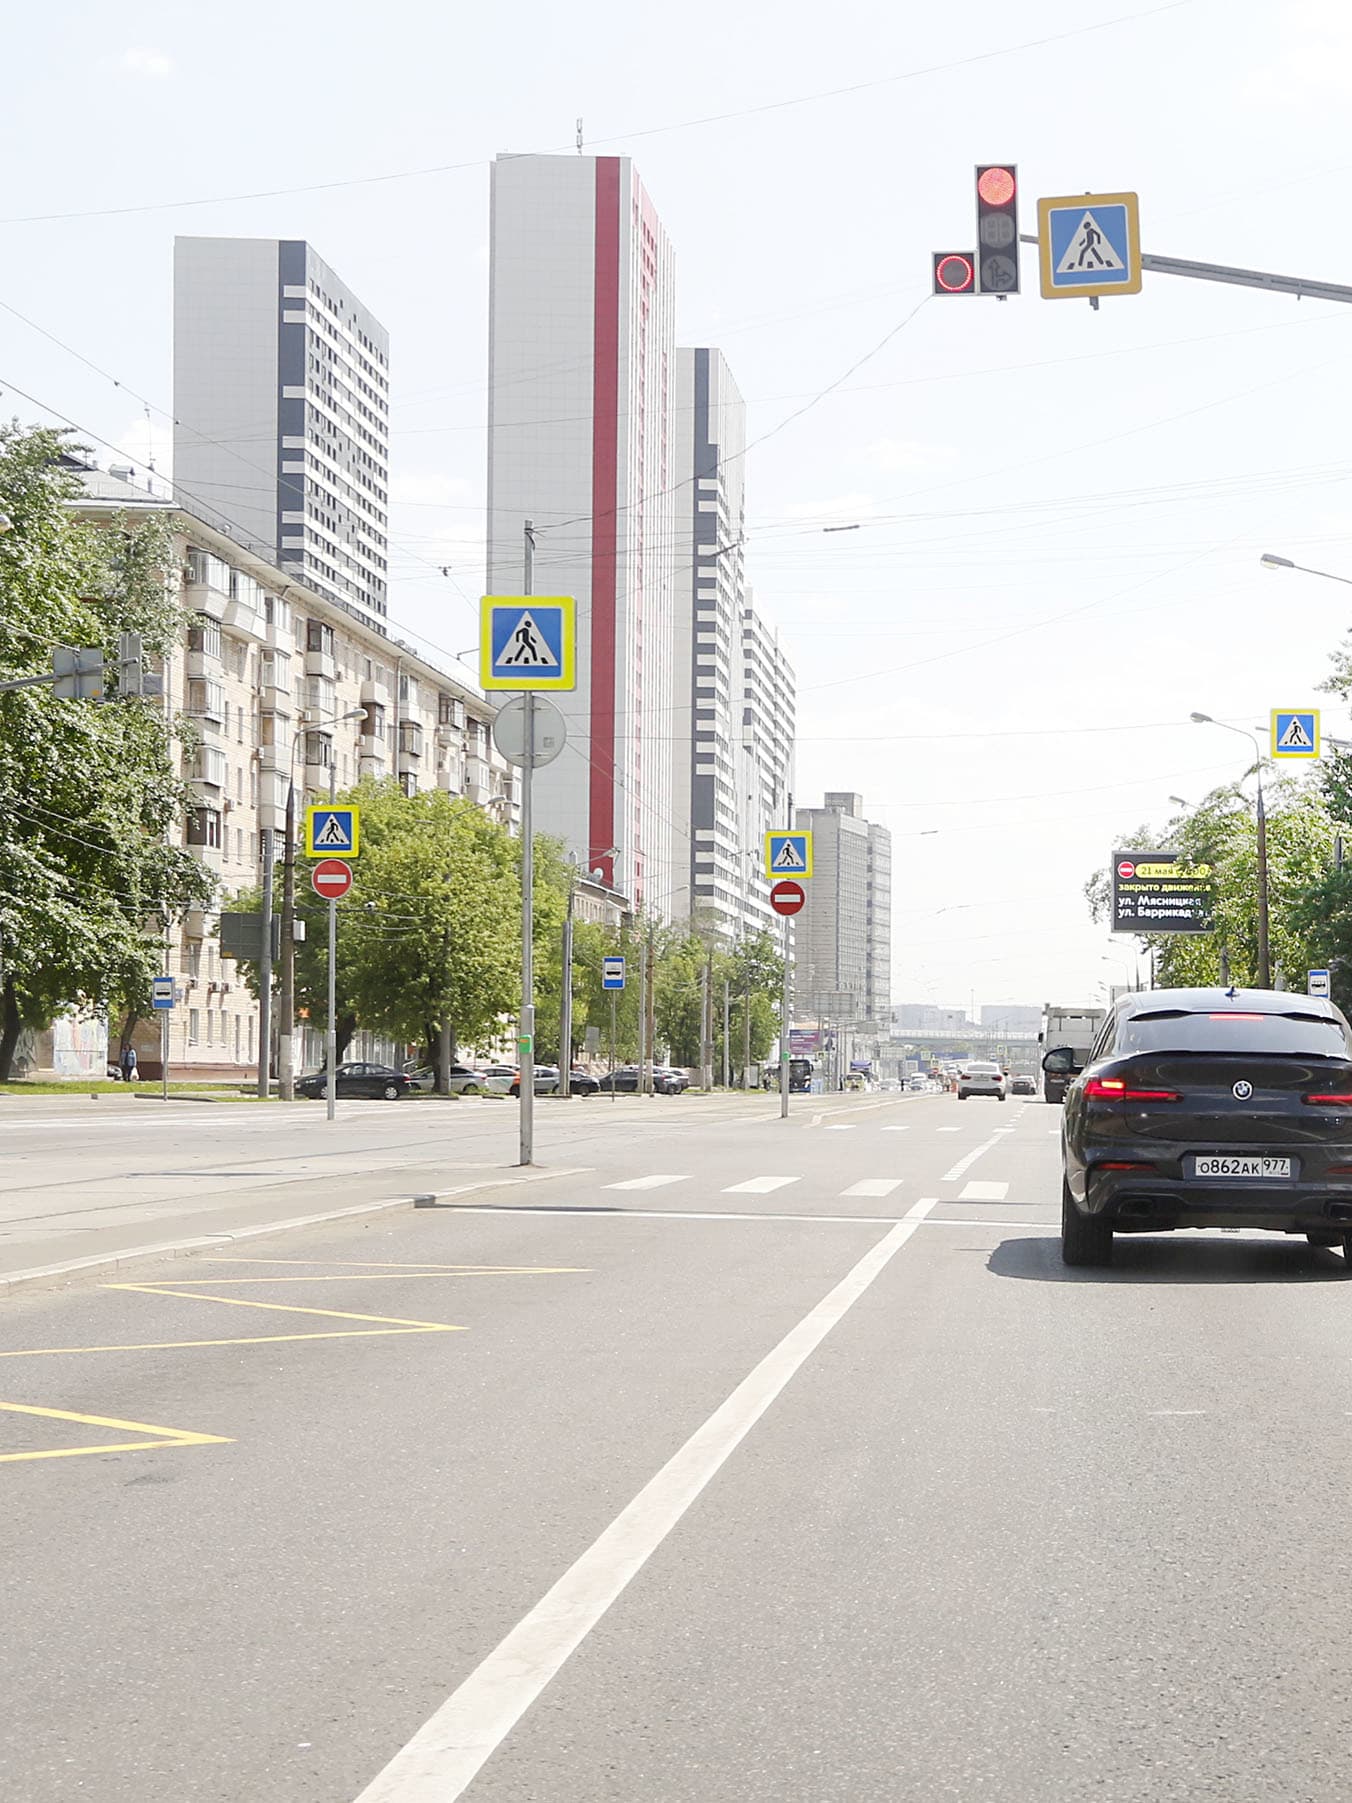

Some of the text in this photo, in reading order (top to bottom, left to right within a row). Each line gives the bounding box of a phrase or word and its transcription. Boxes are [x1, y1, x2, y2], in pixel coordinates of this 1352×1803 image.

[1118, 884, 1160, 893] закрыто
[1118, 897, 1135, 907] ул.
[1118, 908, 1135, 919] ул.
[1263, 1159, 1286, 1171] 977
